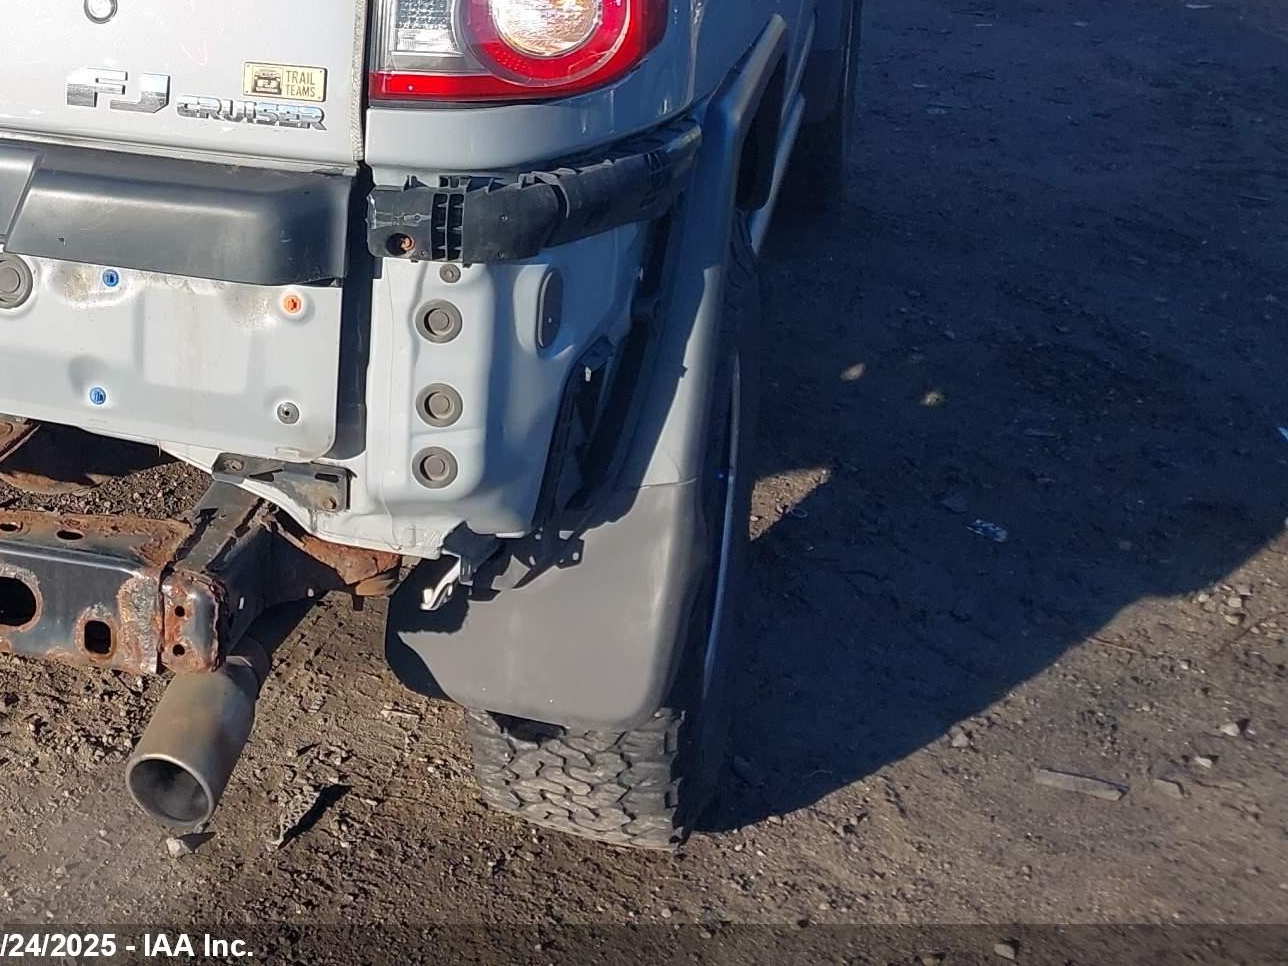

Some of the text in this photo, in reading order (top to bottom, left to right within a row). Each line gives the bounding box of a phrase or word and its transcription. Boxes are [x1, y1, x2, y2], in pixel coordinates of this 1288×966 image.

[286, 70, 316, 85] TRAIL
[285, 84, 316, 97] TEAMS
[66, 67, 327, 131] FJ CRUISER
